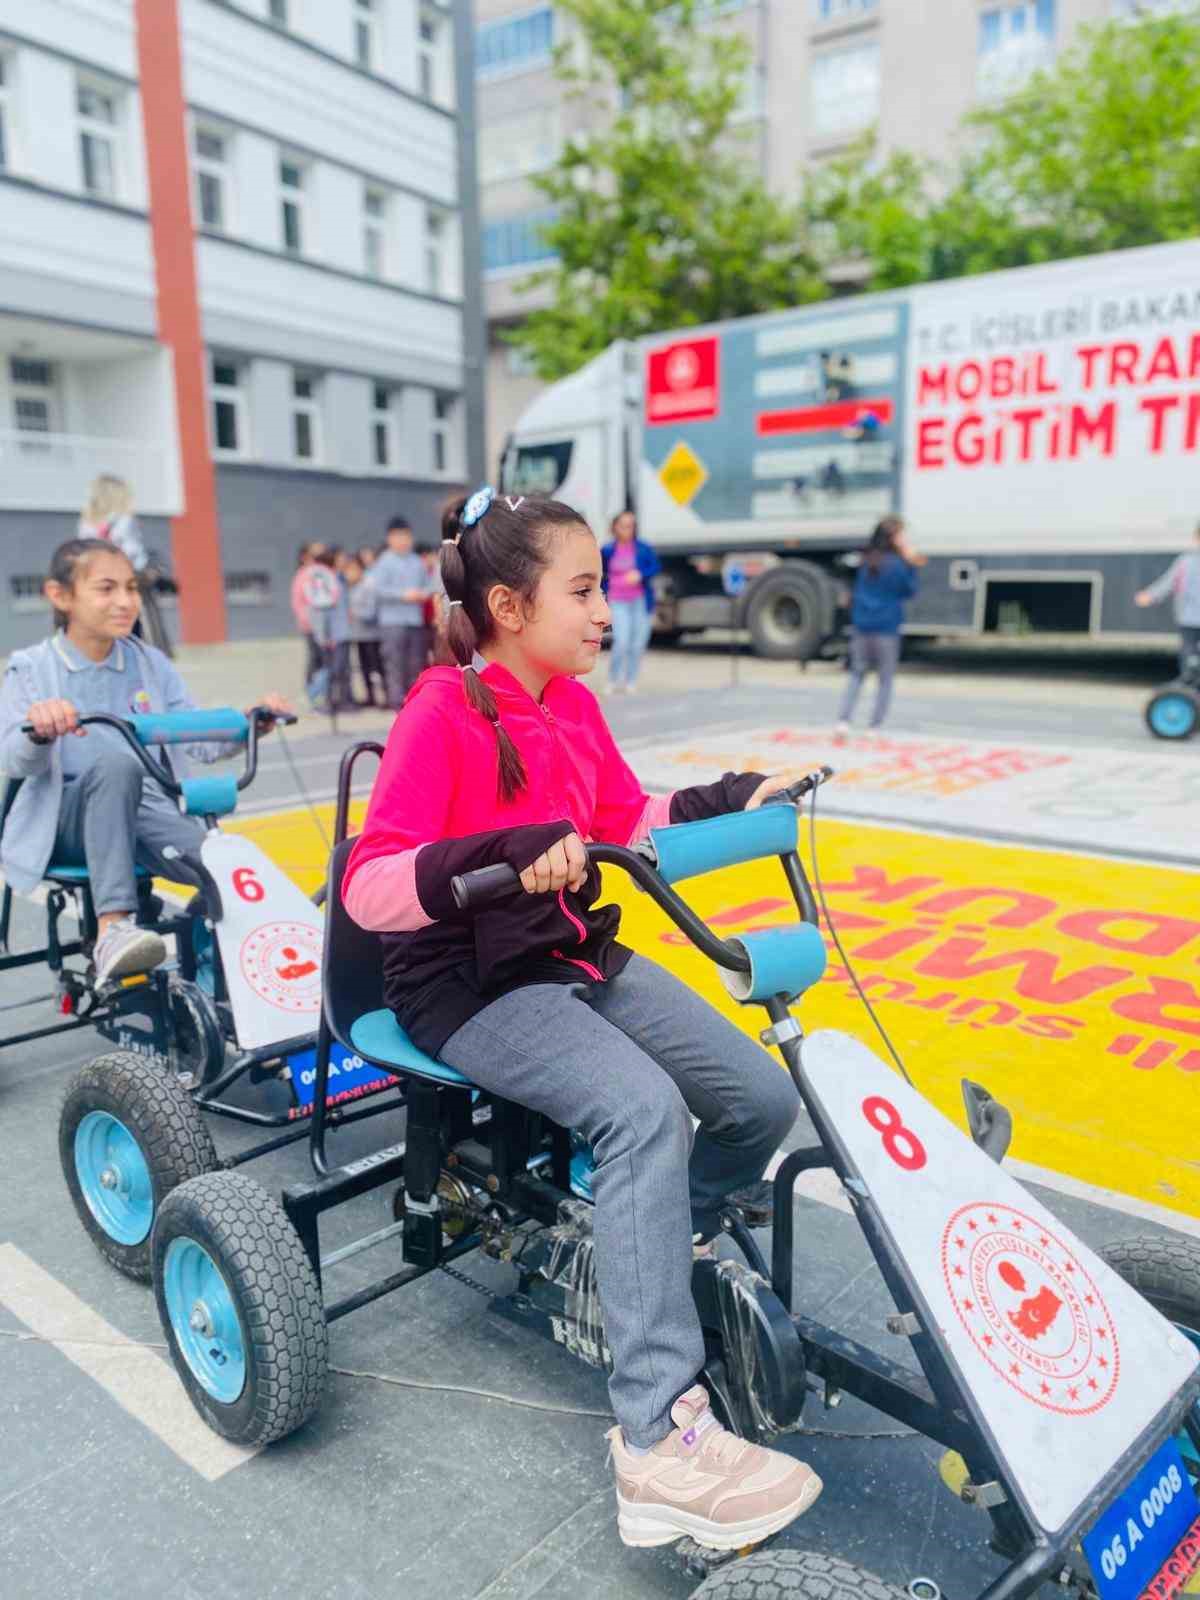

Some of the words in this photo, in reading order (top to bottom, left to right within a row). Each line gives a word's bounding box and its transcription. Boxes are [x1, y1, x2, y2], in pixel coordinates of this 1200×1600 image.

[1099, 288, 1200, 332] BAKA
[231, 867, 265, 903] 6
[328, 1062, 341, 1078] A
[342, 1055, 368, 1072] 00
[862, 1095, 927, 1171] 8
[1101, 1533, 1127, 1580] 06
[1126, 1518, 1144, 1552] A
[1140, 1464, 1182, 1528] 0008
